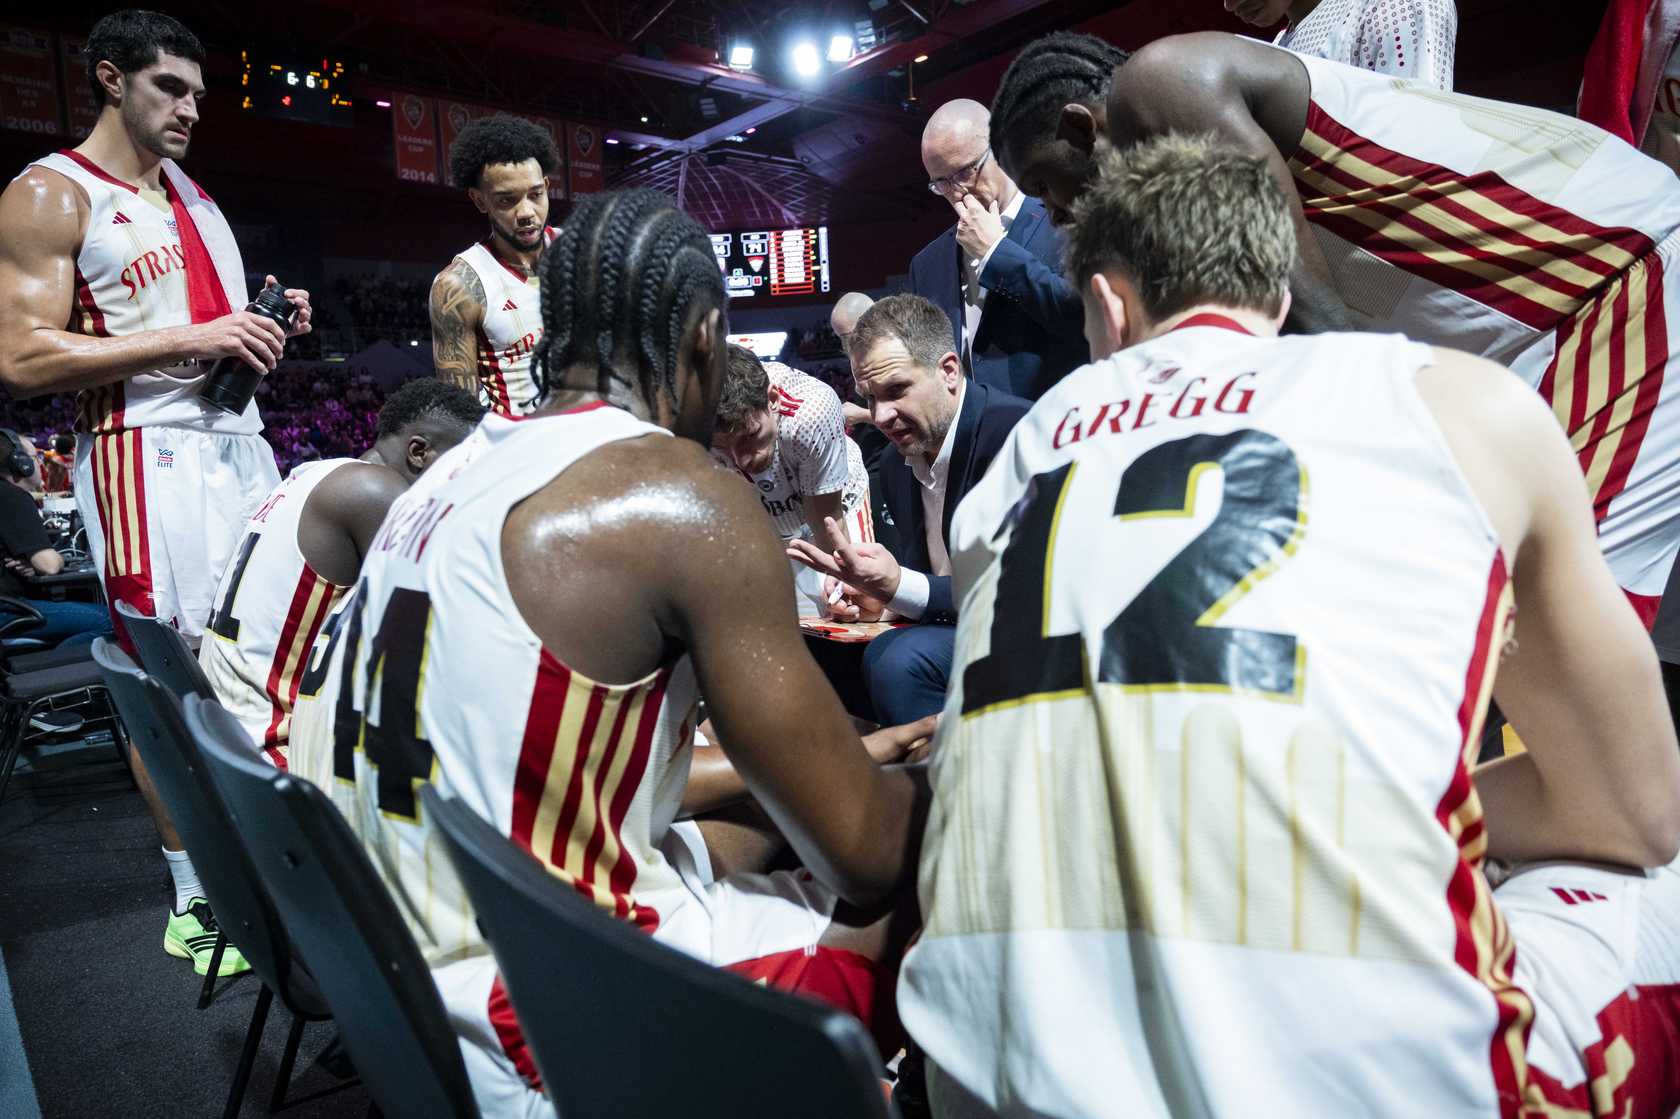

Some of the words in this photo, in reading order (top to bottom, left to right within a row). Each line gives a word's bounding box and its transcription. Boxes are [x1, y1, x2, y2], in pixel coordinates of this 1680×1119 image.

[7, 116, 57, 135] 2006
[400, 168, 435, 183] 2014
[1051, 370, 1259, 450] GREGG
[960, 428, 1310, 718] 12
